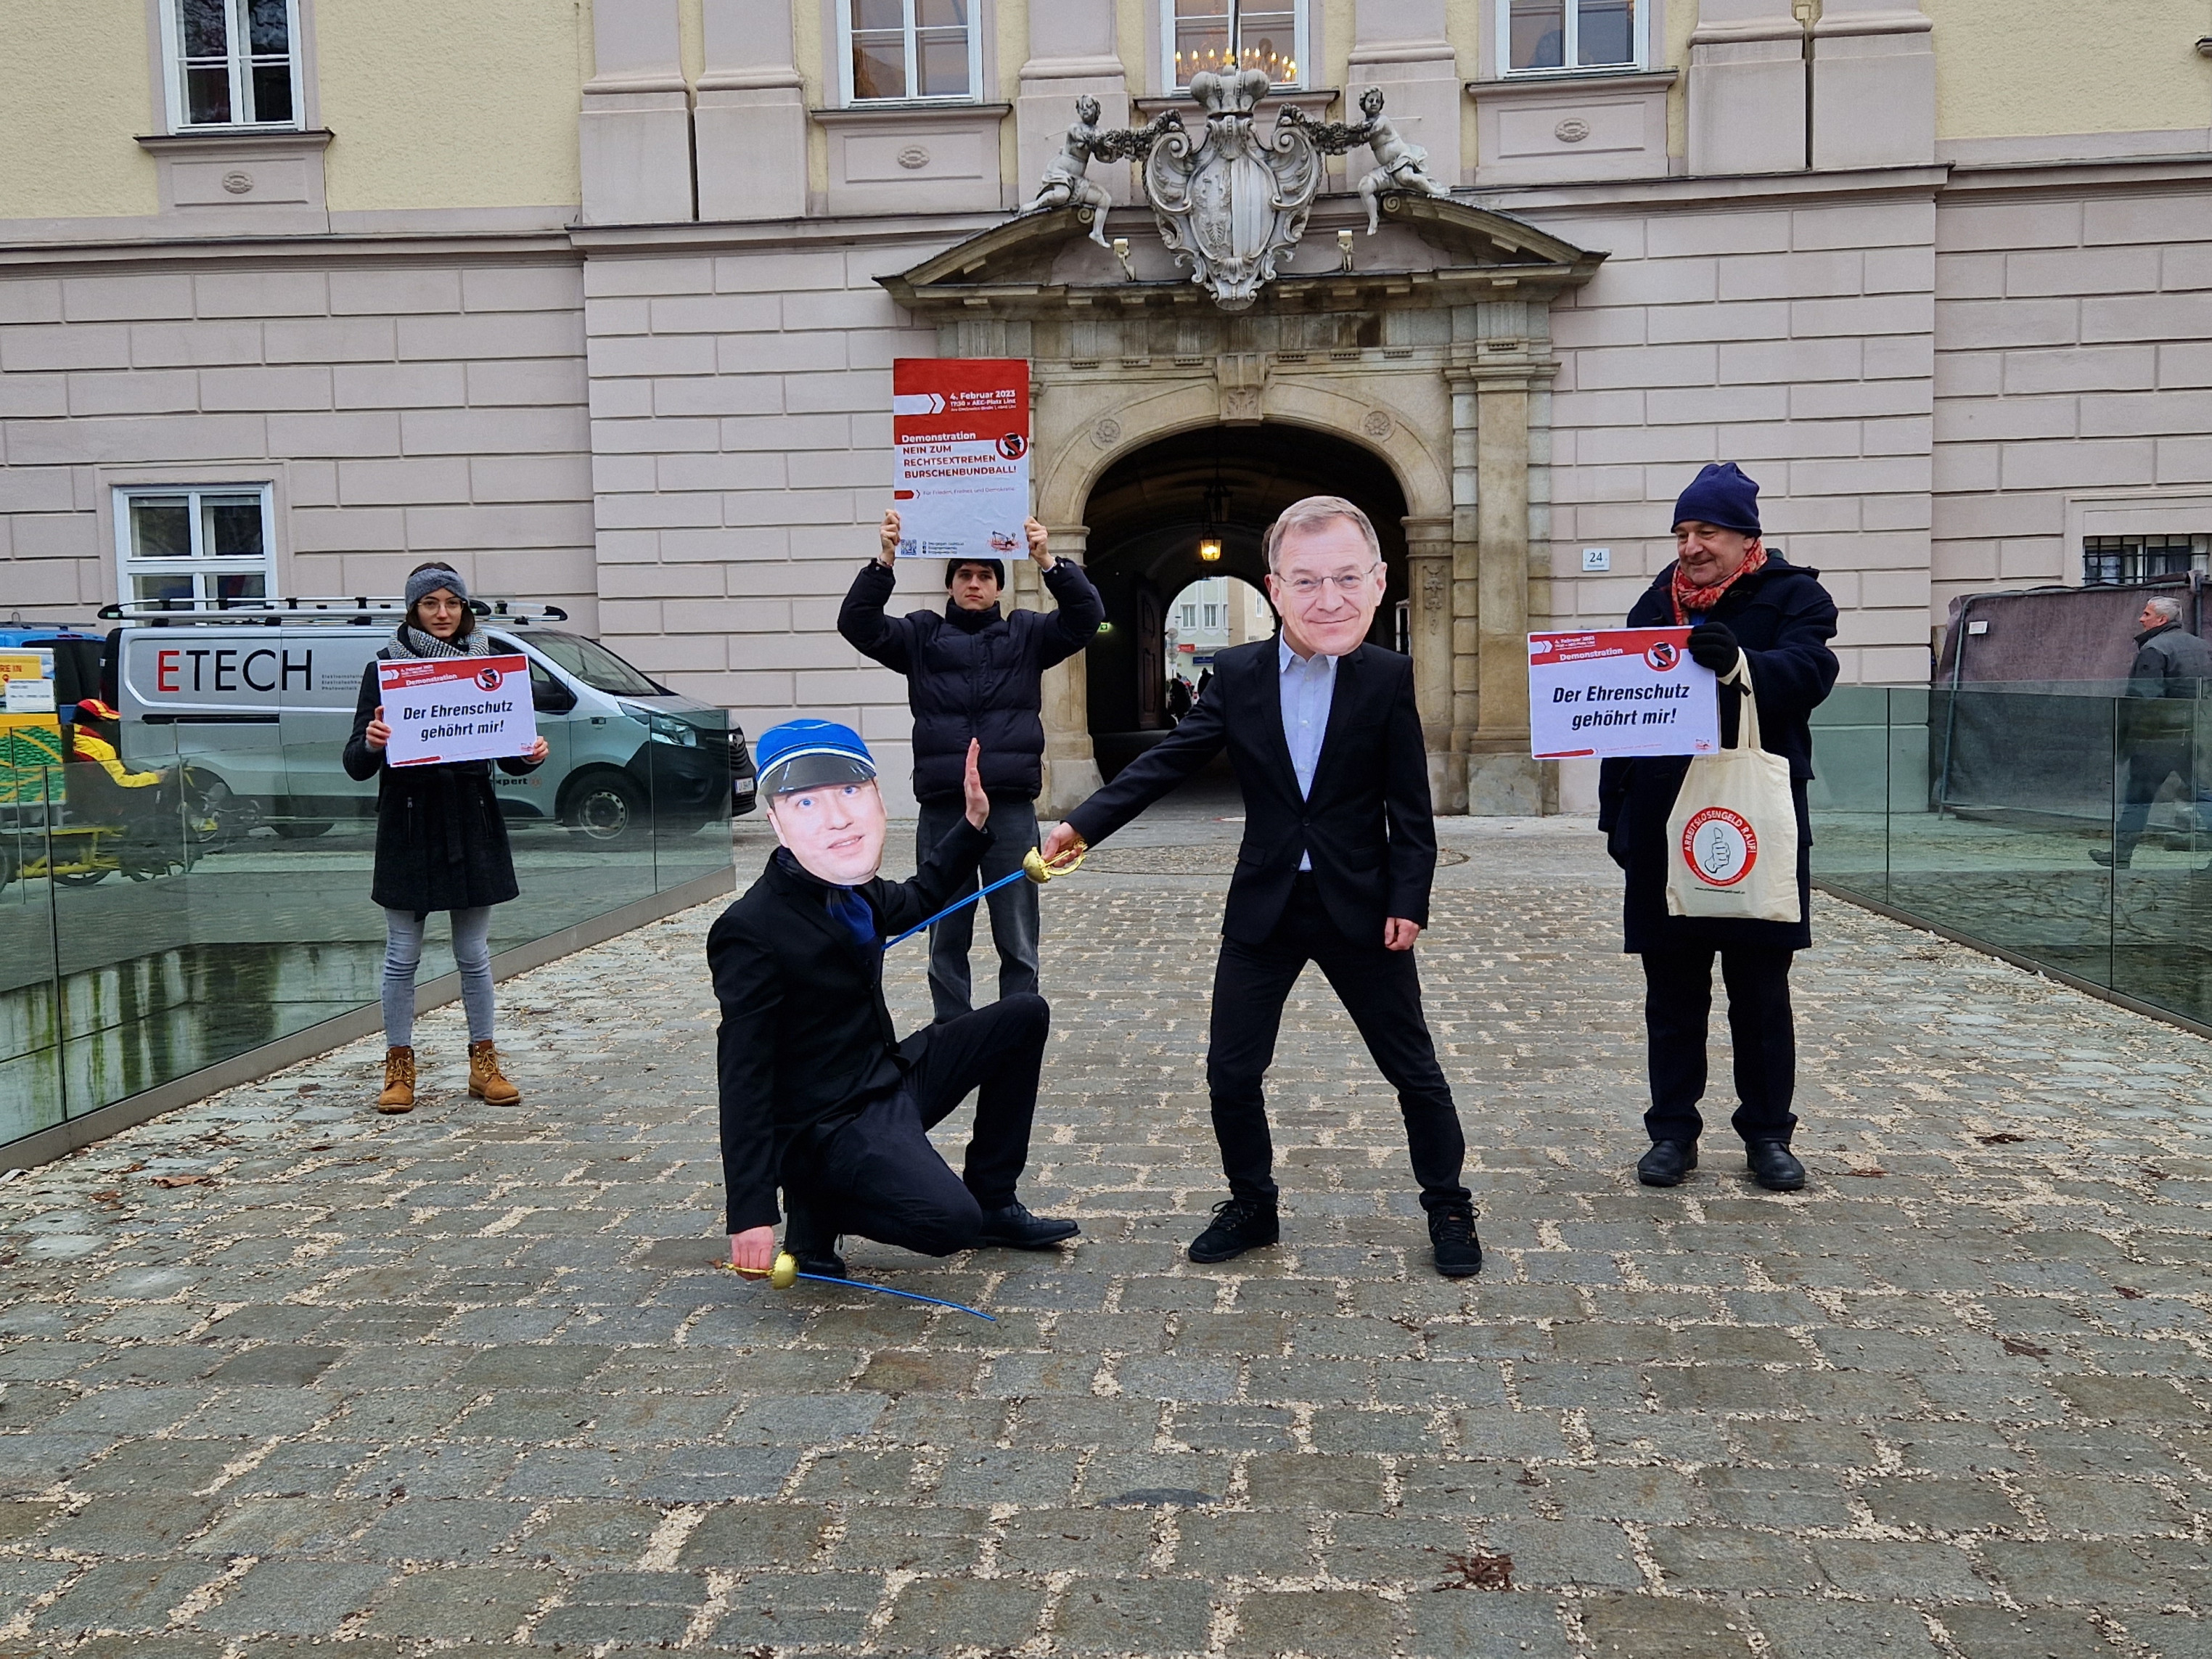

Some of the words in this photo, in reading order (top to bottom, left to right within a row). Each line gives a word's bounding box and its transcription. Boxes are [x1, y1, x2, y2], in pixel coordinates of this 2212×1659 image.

[960, 390, 994, 400] Februar
[995, 389, 1015, 398] 2023
[901, 430, 976, 443] Demonstration
[930, 445, 951, 454] ZUM
[904, 455, 996, 467] RECHTSEXTREMEN
[904, 465, 1017, 478] BURSCHENBUNDBALL!
[1589, 552, 1602, 562] 24
[1560, 647, 1623, 661] Demonstration
[157, 649, 312, 692] ETECH
[406, 673, 458, 686] Demonstration
[1553, 687, 1581, 702] Der
[1586, 684, 1690, 702] Ehrenschutz
[404, 707, 427, 720] Der
[431, 700, 513, 718] Ehrenschutz
[1572, 710, 1638, 731] gehöhrt
[1642, 708, 1677, 725] mir!
[421, 723, 473, 742] gehöhrt
[478, 720, 504, 734] mir!
[1684, 810, 1743, 852] ARBEITSLOSENGELD
[1741, 827, 1756, 853] RAUF!
